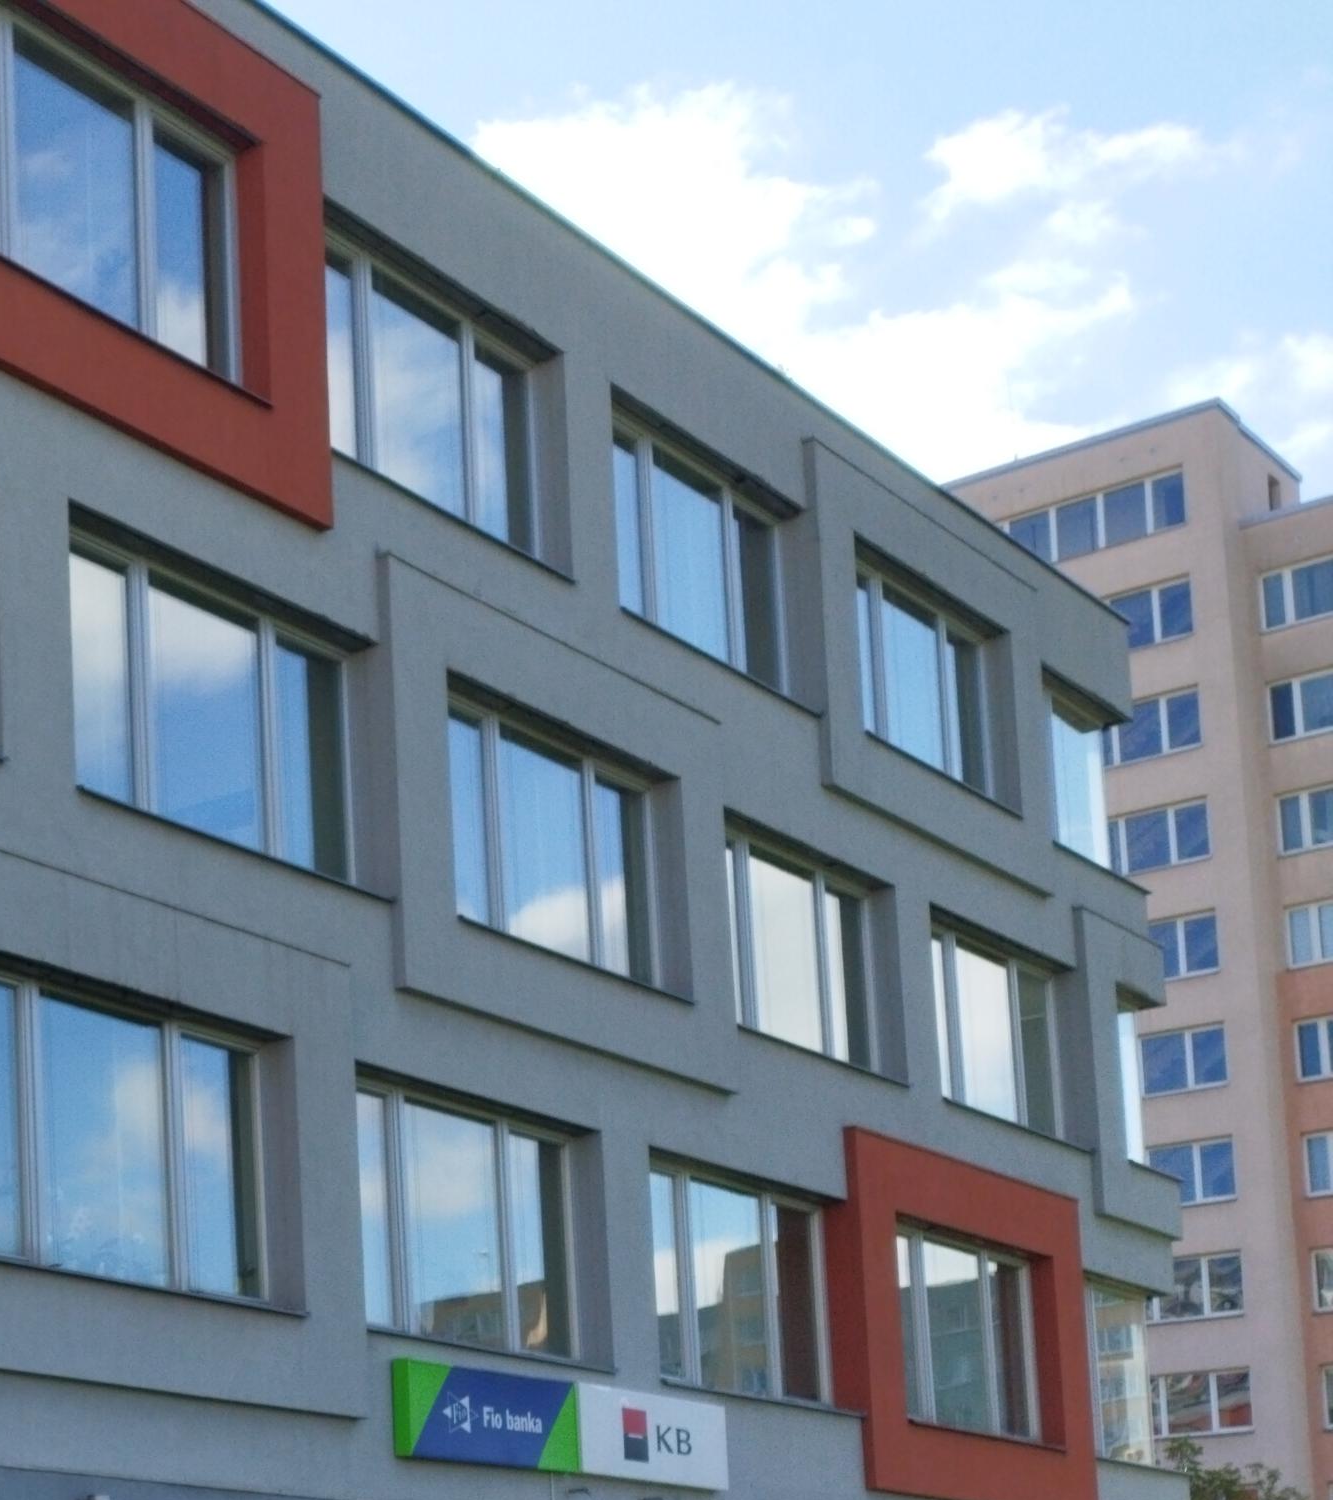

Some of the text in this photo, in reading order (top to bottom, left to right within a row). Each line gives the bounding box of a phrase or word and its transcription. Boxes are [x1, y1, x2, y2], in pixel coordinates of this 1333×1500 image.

[482, 1405, 543, 1434] Fio banka
[655, 1424, 693, 1456] KB
